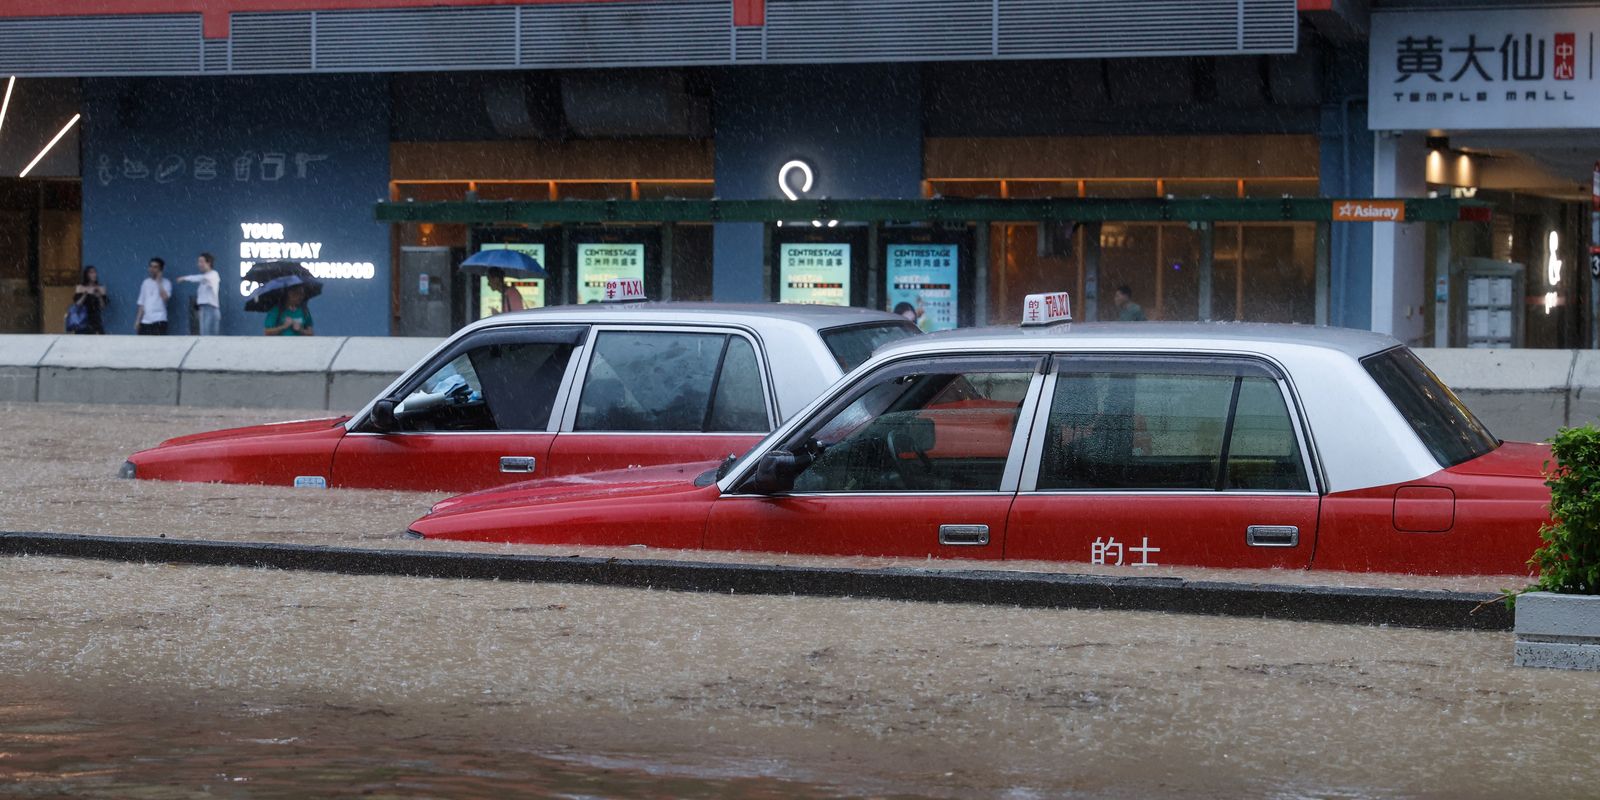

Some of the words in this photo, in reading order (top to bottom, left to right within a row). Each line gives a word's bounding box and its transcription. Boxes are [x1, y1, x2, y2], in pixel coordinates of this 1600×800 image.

[1555, 42, 1573, 79] 中心
[1394, 92, 1487, 102] TEMPLE
[1506, 91, 1575, 101] MALL
[1354, 204, 1399, 220] Asiaray
[240, 222, 284, 240] YOUR
[240, 242, 322, 259] EVERYDAY
[584, 249, 637, 257] CENTRESTAGE
[788, 249, 843, 257] CENTRESTAGE
[894, 249, 951, 257] CENTRESTAGE
[240, 261, 375, 279] NURHOOD
[620, 280, 643, 296] TAXI
[1028, 300, 1039, 319] 的士
[1045, 294, 1069, 317] TAXI
[1091, 536, 1161, 566] 的士
